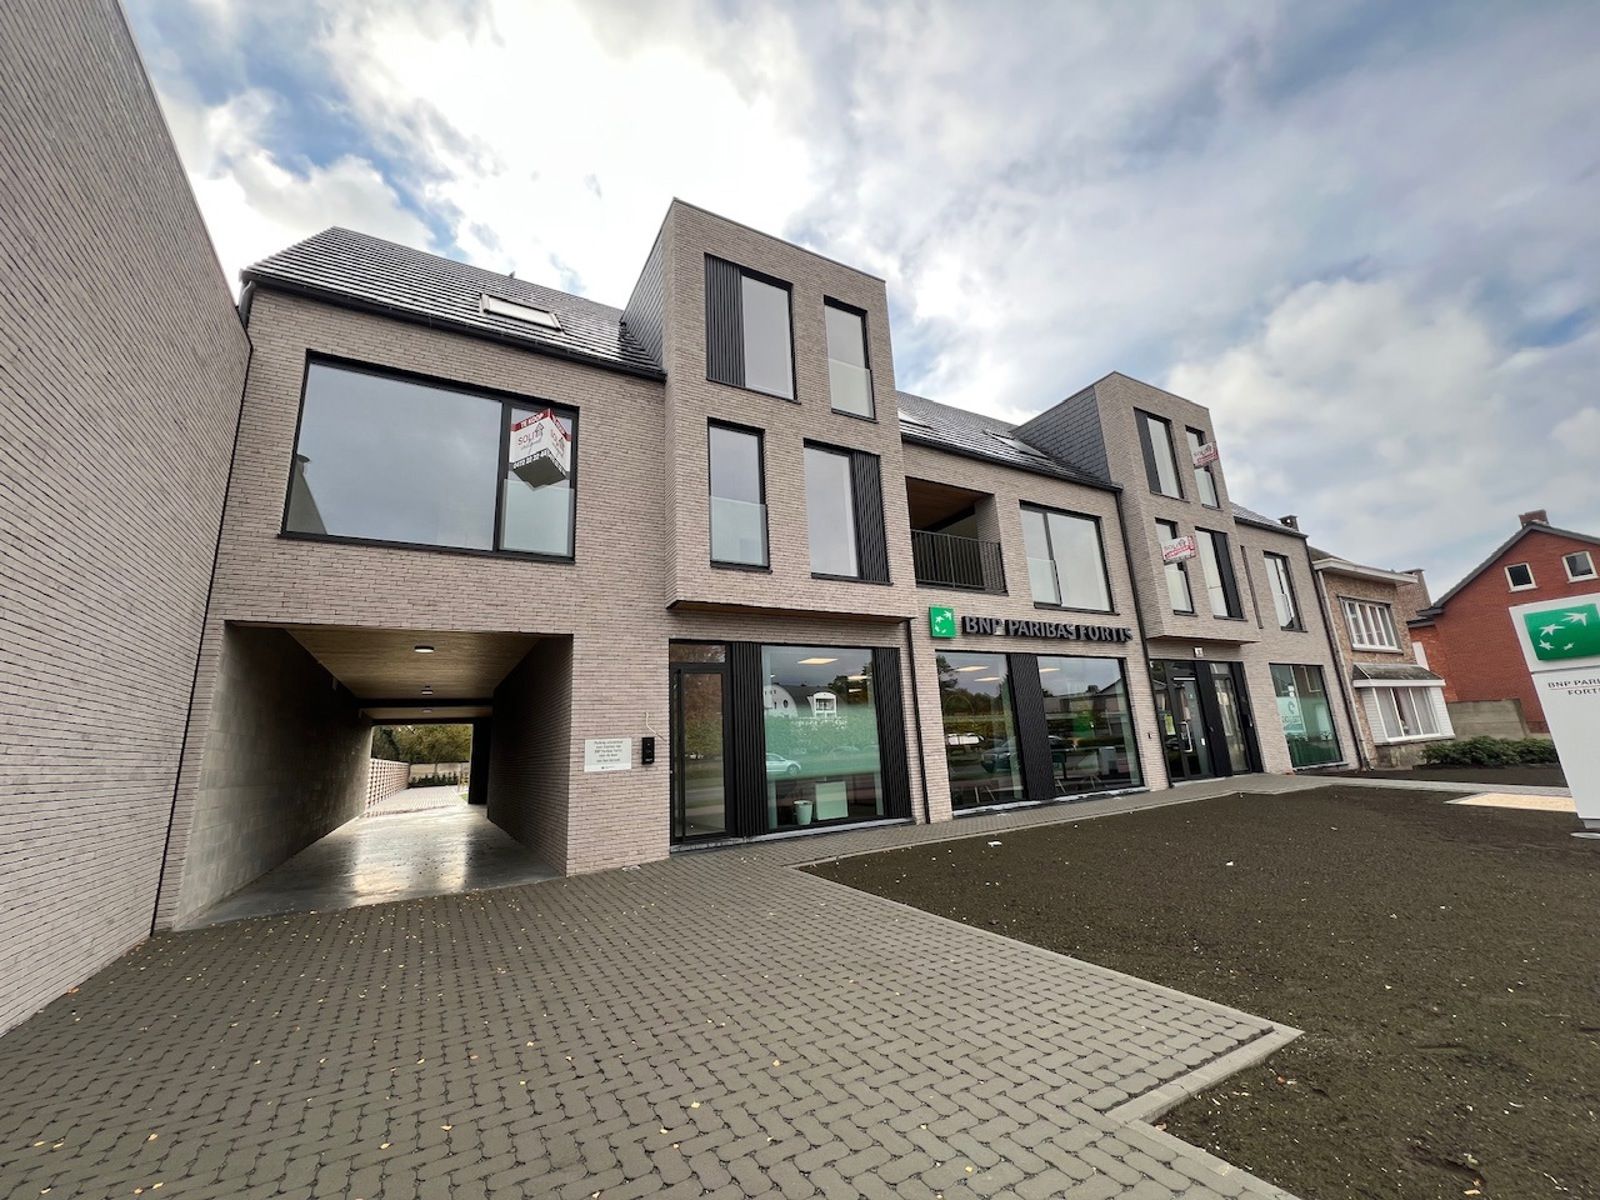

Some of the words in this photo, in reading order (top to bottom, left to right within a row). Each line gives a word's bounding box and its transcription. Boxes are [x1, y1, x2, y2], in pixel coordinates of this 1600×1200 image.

[962, 616, 1004, 636] BNP
[1006, 619, 1077, 640] PARIBAS
[1078, 624, 1133, 643] FORTIS
